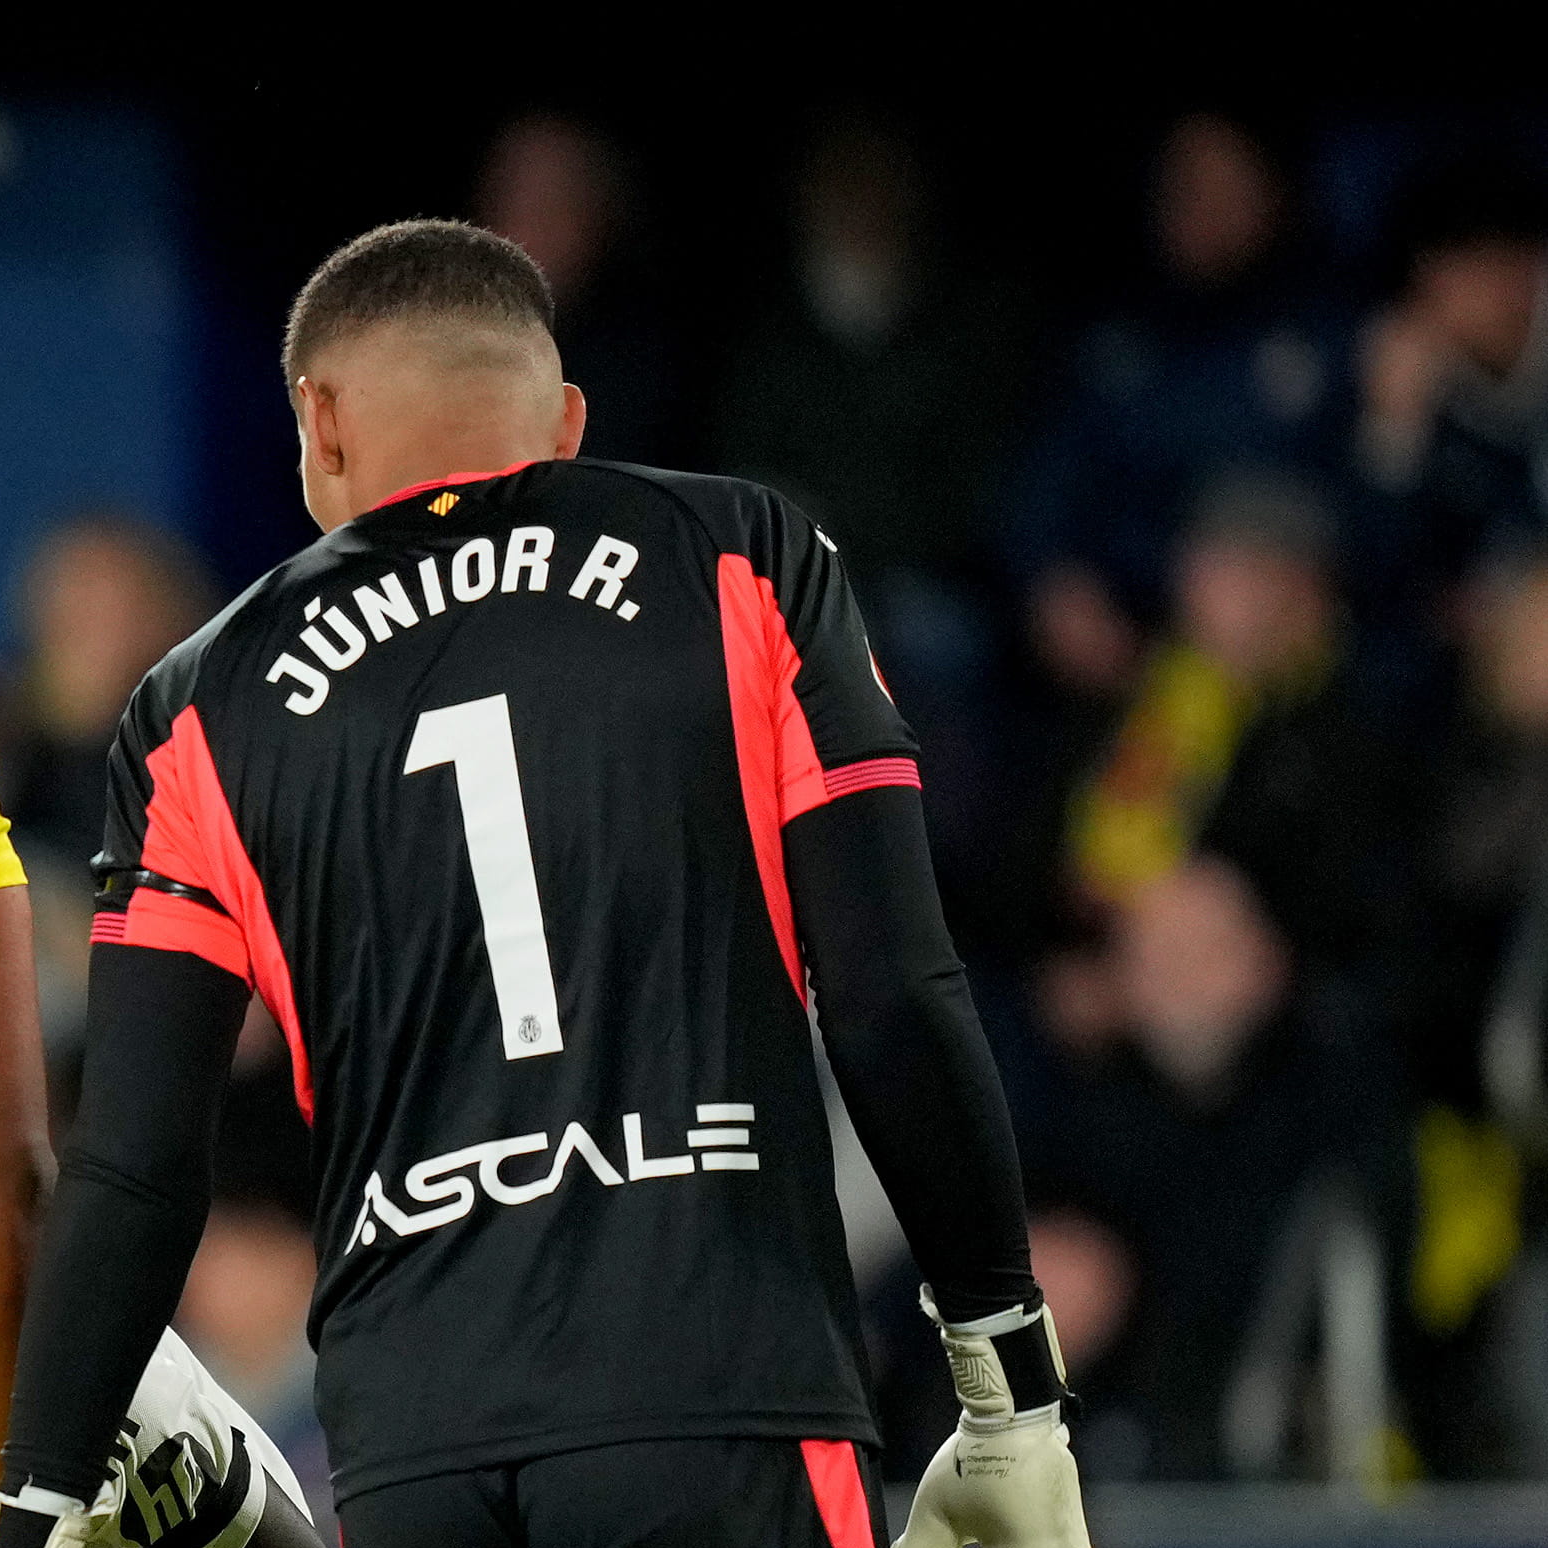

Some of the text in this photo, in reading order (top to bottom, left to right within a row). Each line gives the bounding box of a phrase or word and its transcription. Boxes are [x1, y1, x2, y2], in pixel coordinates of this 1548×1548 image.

[265, 524, 642, 717] JÚNIOR R.
[403, 692, 565, 1061] 1
[344, 1103, 760, 1256] ASCALE
